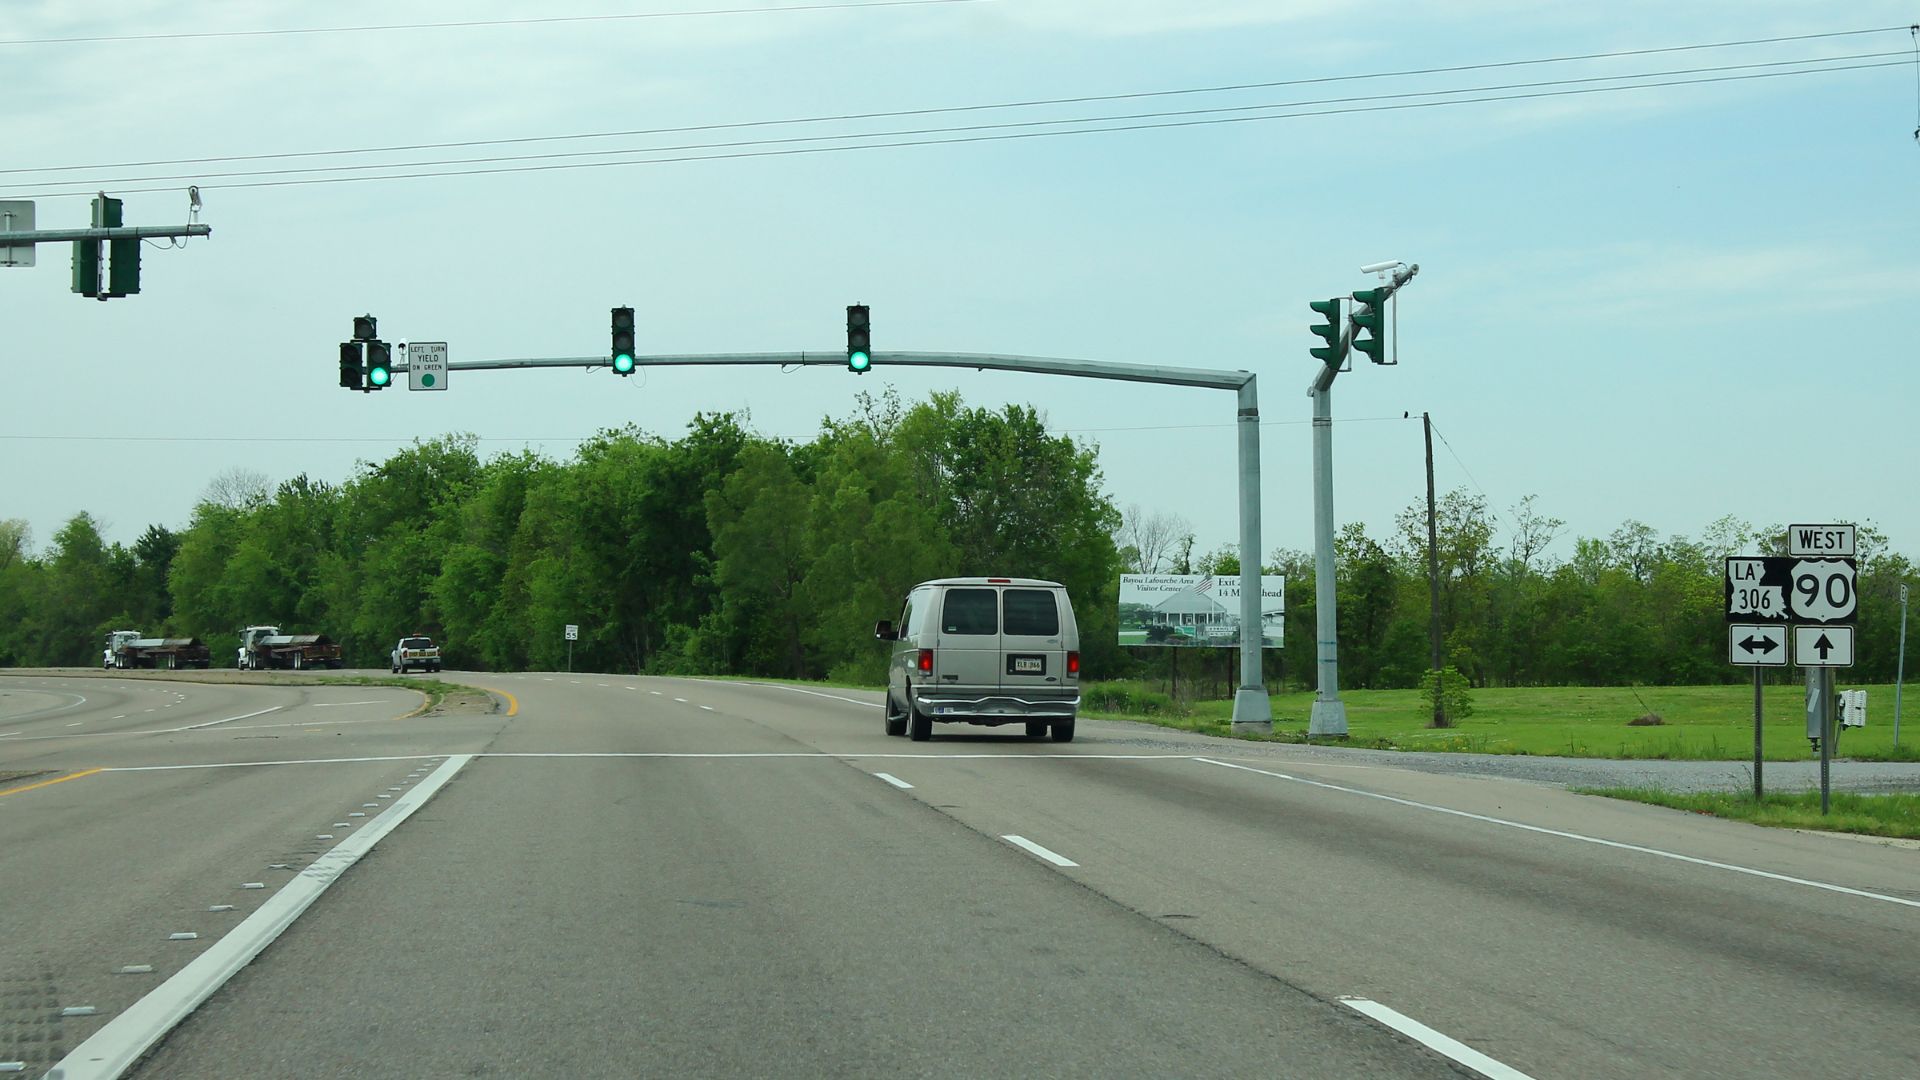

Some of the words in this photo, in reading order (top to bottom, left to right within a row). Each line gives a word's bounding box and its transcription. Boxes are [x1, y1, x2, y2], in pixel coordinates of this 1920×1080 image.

[418, 354, 438, 362] YIELD
[1799, 530, 1845, 549] WEST
[1735, 563, 1755, 580] LA
[1123, 576, 1143, 584] Bayou
[1219, 577, 1235, 586] Exit
[1137, 584, 1158, 592] Visitor
[1160, 584, 1182, 592] Center
[1219, 589, 1228, 597] 14
[1262, 588, 1282, 598] head
[1796, 573, 1850, 608] 90
[1739, 589, 1770, 609] 306
